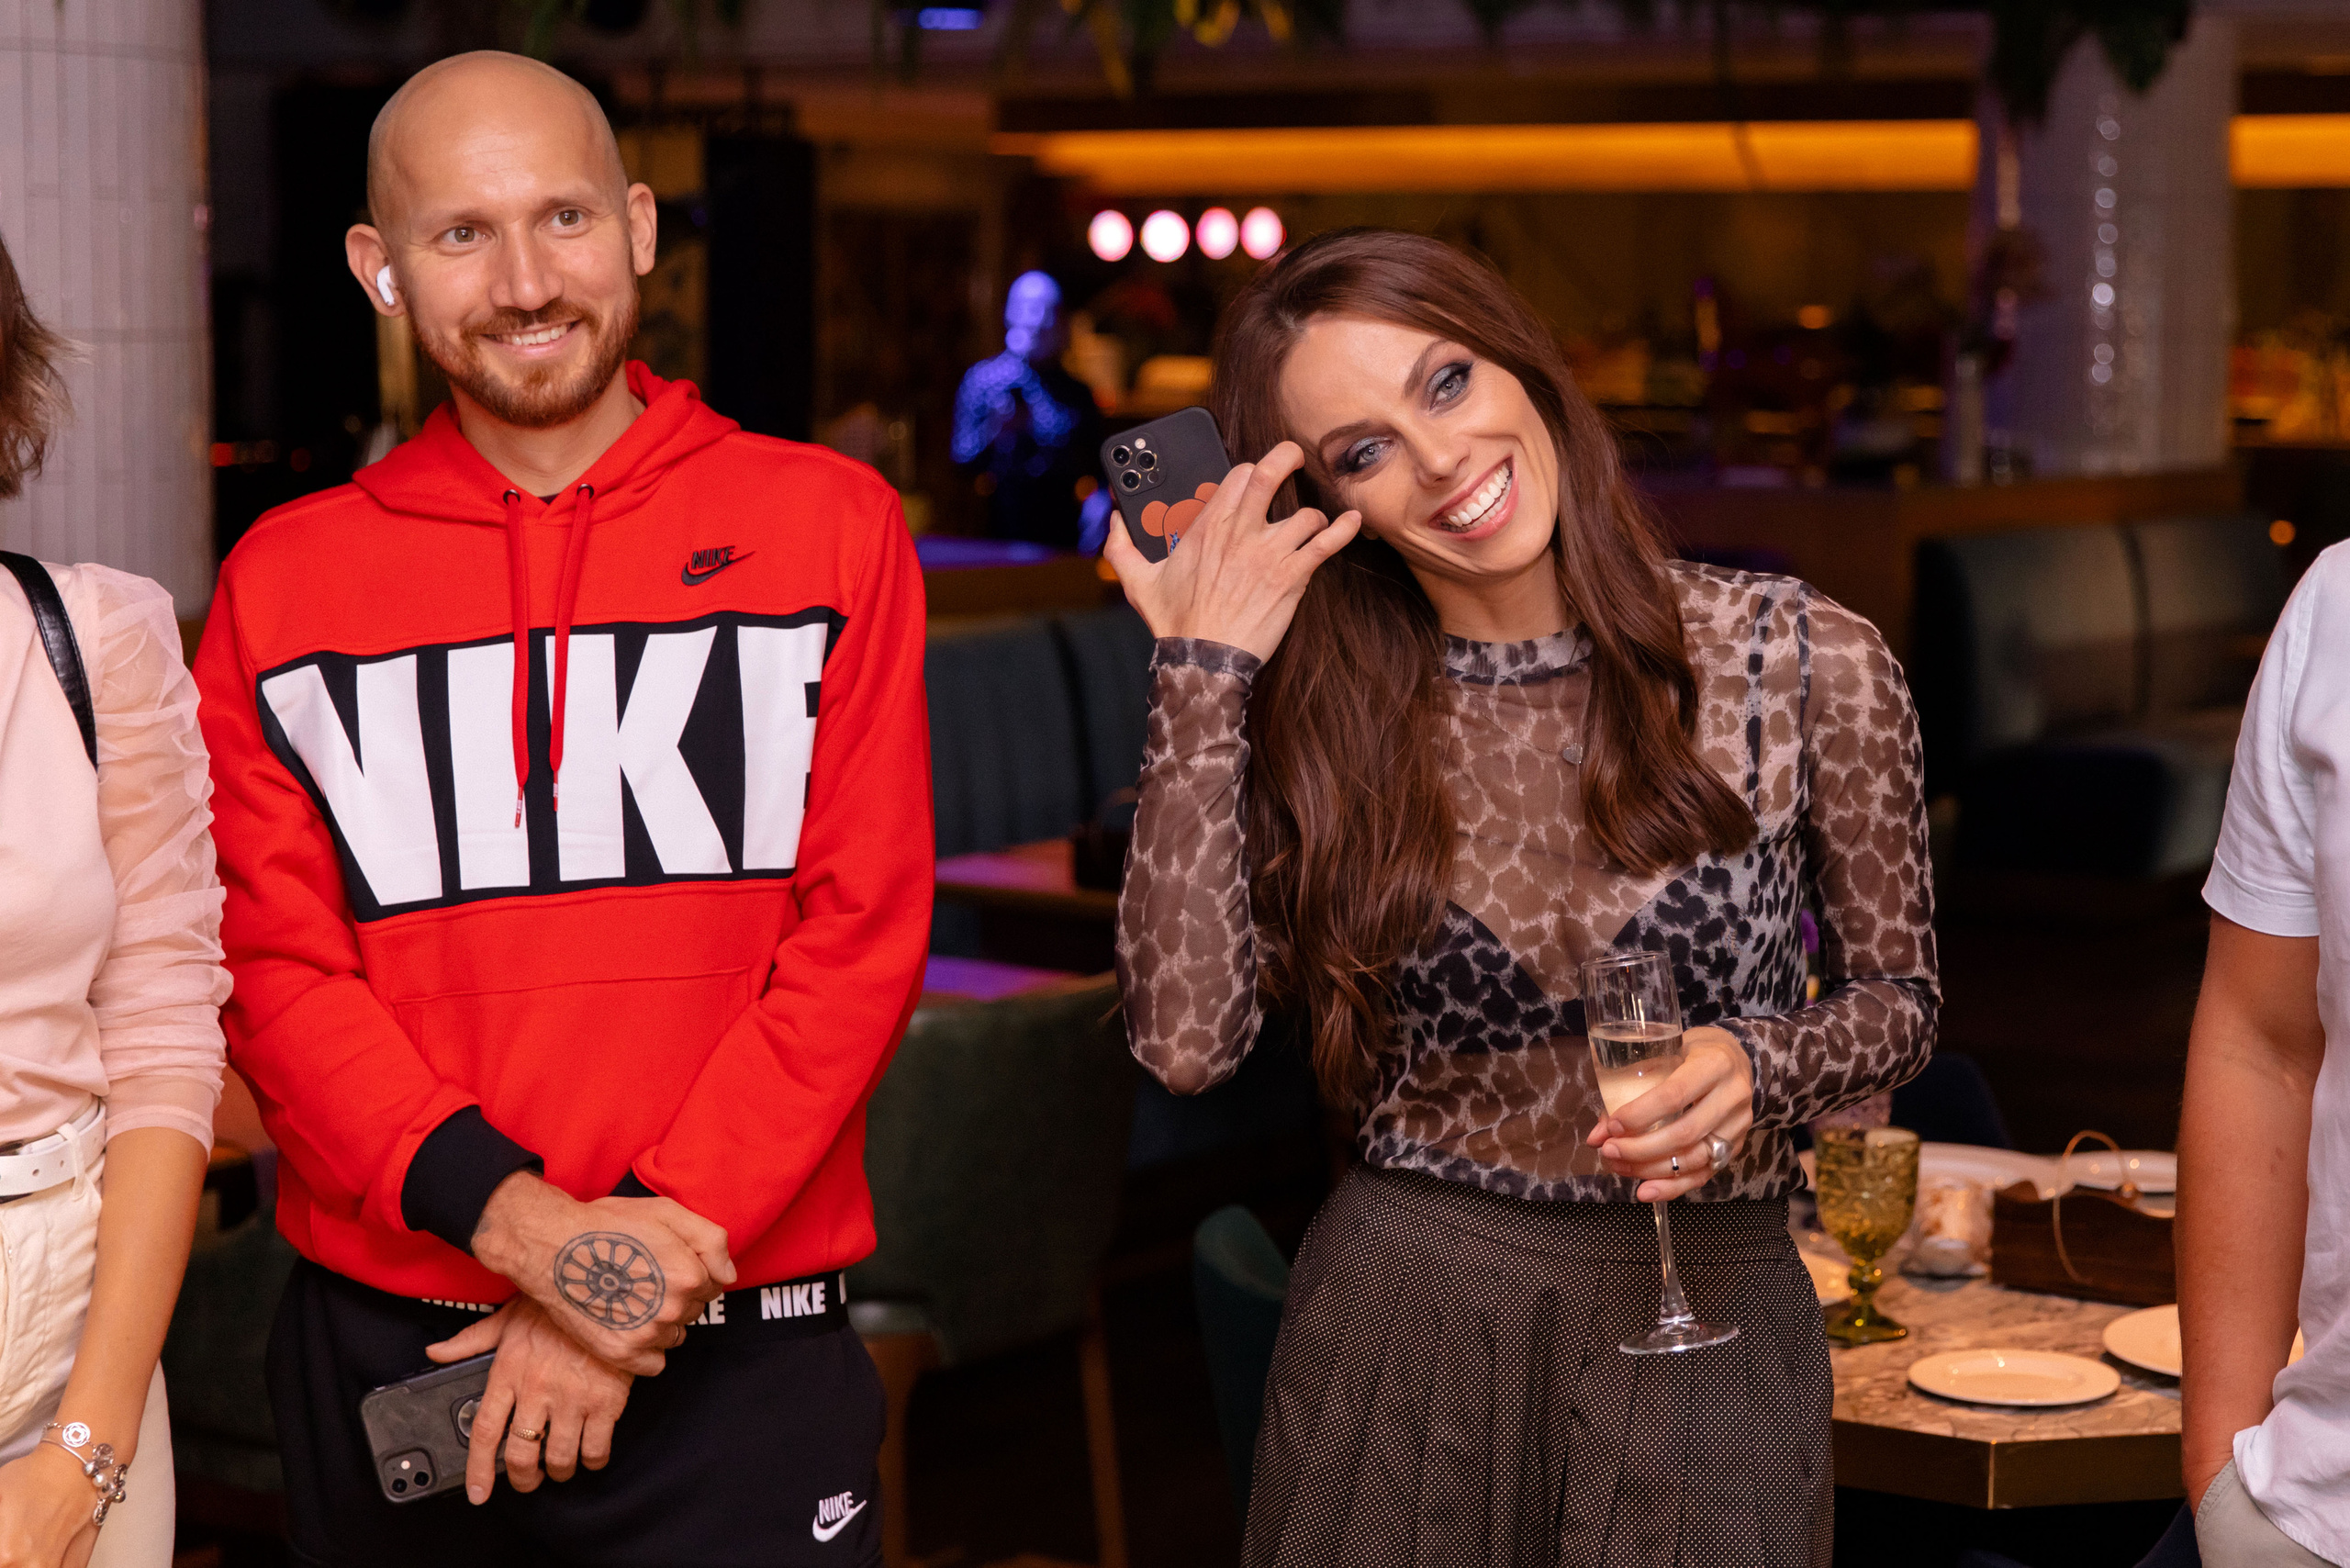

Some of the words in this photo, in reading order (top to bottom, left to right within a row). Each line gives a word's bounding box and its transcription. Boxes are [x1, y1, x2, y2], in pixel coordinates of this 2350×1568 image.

[690, 545, 735, 569] NIKE
[262, 622, 829, 907] NIKE
[760, 1281, 826, 1320] NIKE
[819, 1491, 854, 1525] NIKE
